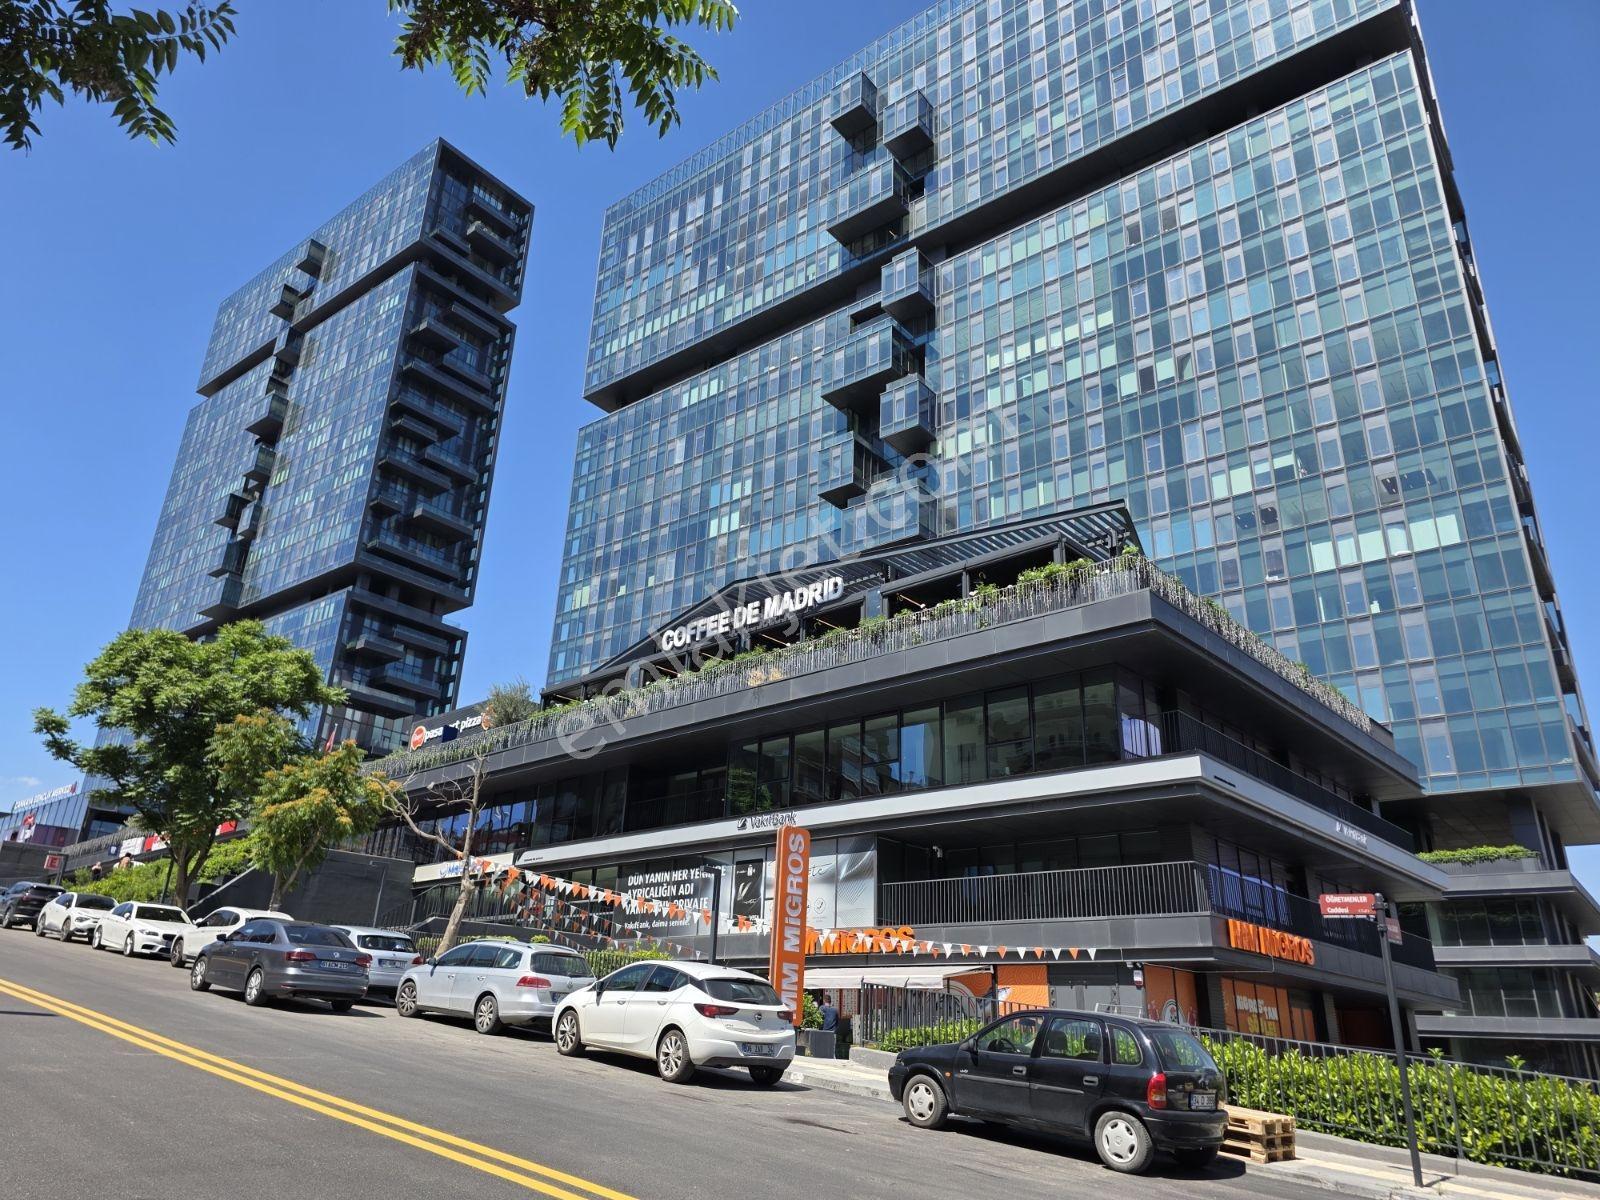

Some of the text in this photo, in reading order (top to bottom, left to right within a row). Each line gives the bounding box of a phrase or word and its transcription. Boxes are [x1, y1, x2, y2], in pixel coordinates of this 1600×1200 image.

[661, 576, 844, 651] COFFEE DE MADRID
[460, 715, 482, 733] pizza
[671, 869, 688, 881] HER
[678, 883, 694, 895] ADI
[1325, 895, 1368, 903] ÖĞRETMENLER
